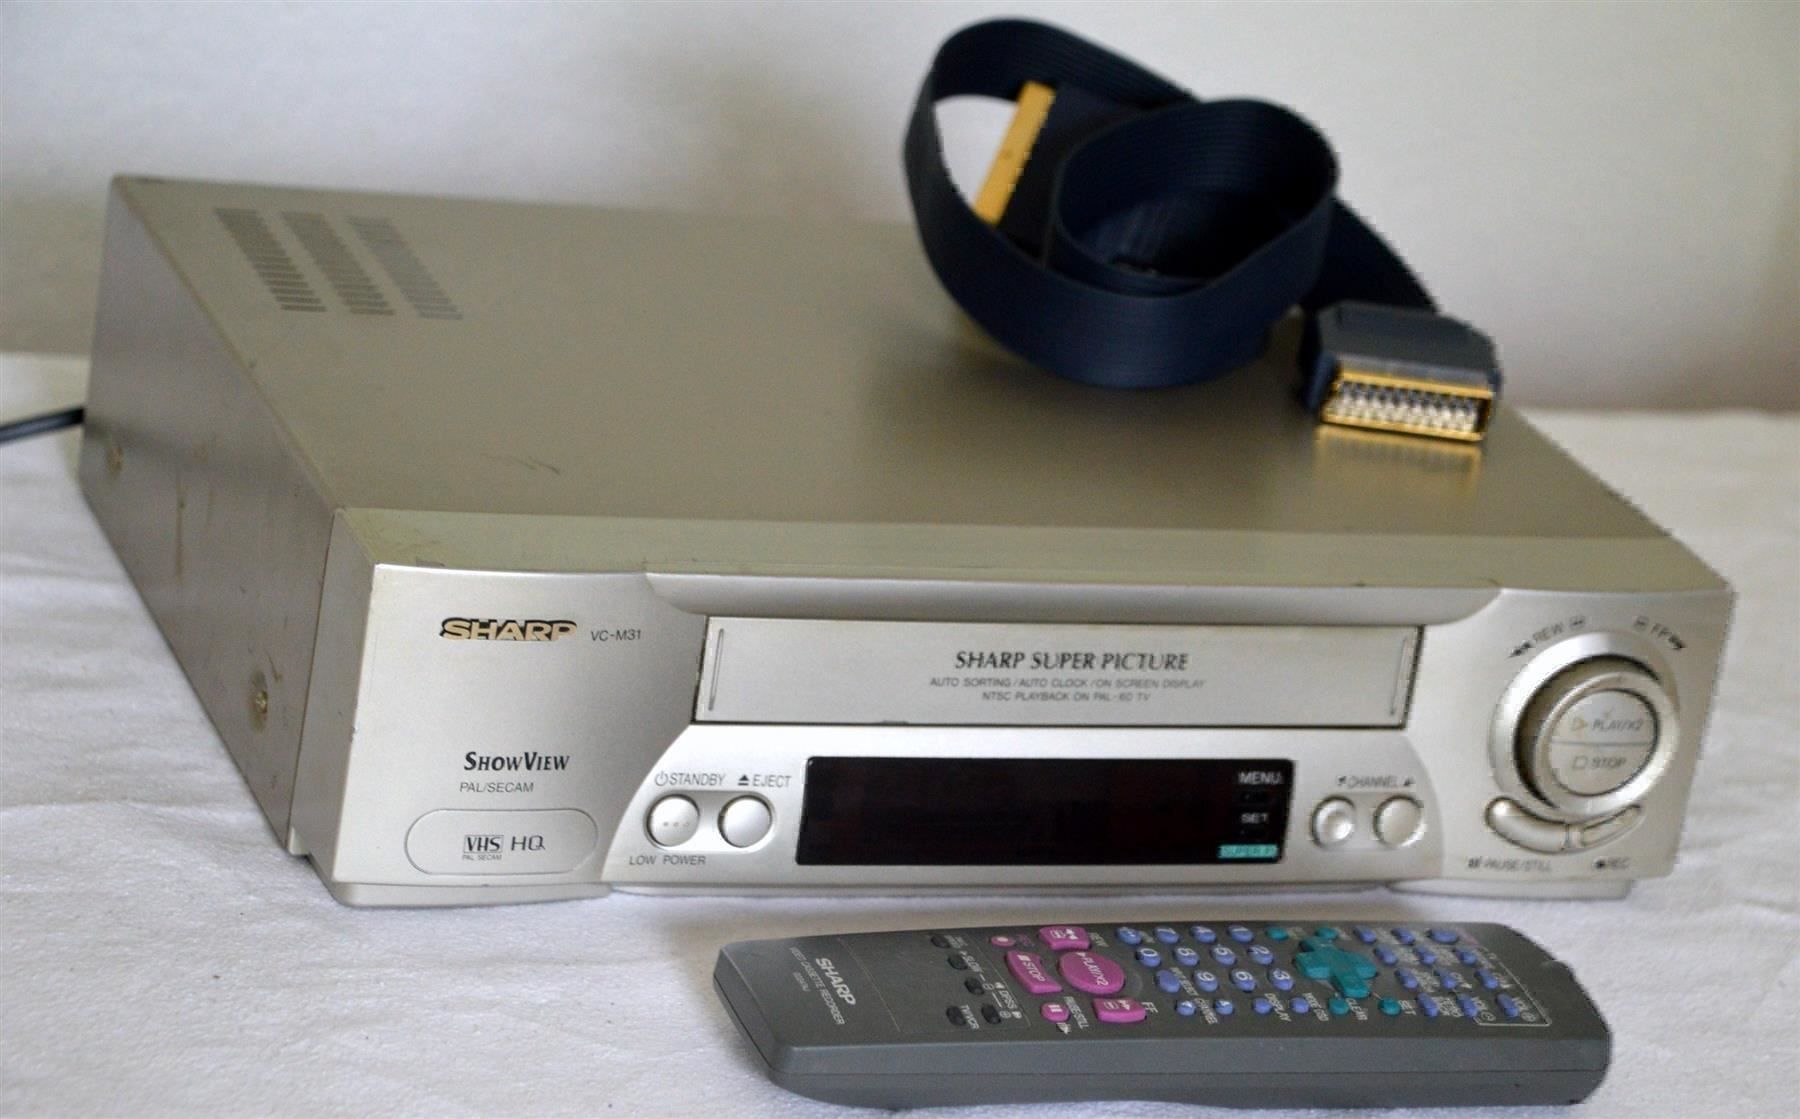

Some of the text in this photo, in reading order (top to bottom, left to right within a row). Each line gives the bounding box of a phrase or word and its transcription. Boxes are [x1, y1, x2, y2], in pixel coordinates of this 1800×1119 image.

[440, 617, 641, 642] SHARP VC-M31
[955, 650, 1189, 671] SHARP SUPER PICTURE
[930, 677, 959, 687] AUTO
[982, 691, 1011, 701] NTSC
[1015, 691, 1069, 701] PLAYBACK
[1073, 692, 1090, 701] ON
[1137, 692, 1152, 701] TV
[1591, 757, 1626, 769] STOP
[669, 773, 727, 786] STANDBY
[752, 774, 792, 787] EJECT
[1238, 771, 1282, 784] MENU
[459, 782, 534, 793] PAL/SECAM
[466, 835, 546, 852] VHS HQ
[629, 856, 707, 866] LOW POWER
[1022, 961, 1046, 982] STOP
[1195, 970, 1216, 981] 9
[815, 957, 857, 1005] SHARP
[817, 988, 846, 1025] RECORDER
[1141, 1001, 1159, 1014] FF
[1264, 993, 1292, 1022] DISPLAY
[1345, 998, 1369, 1021] CLEAR
